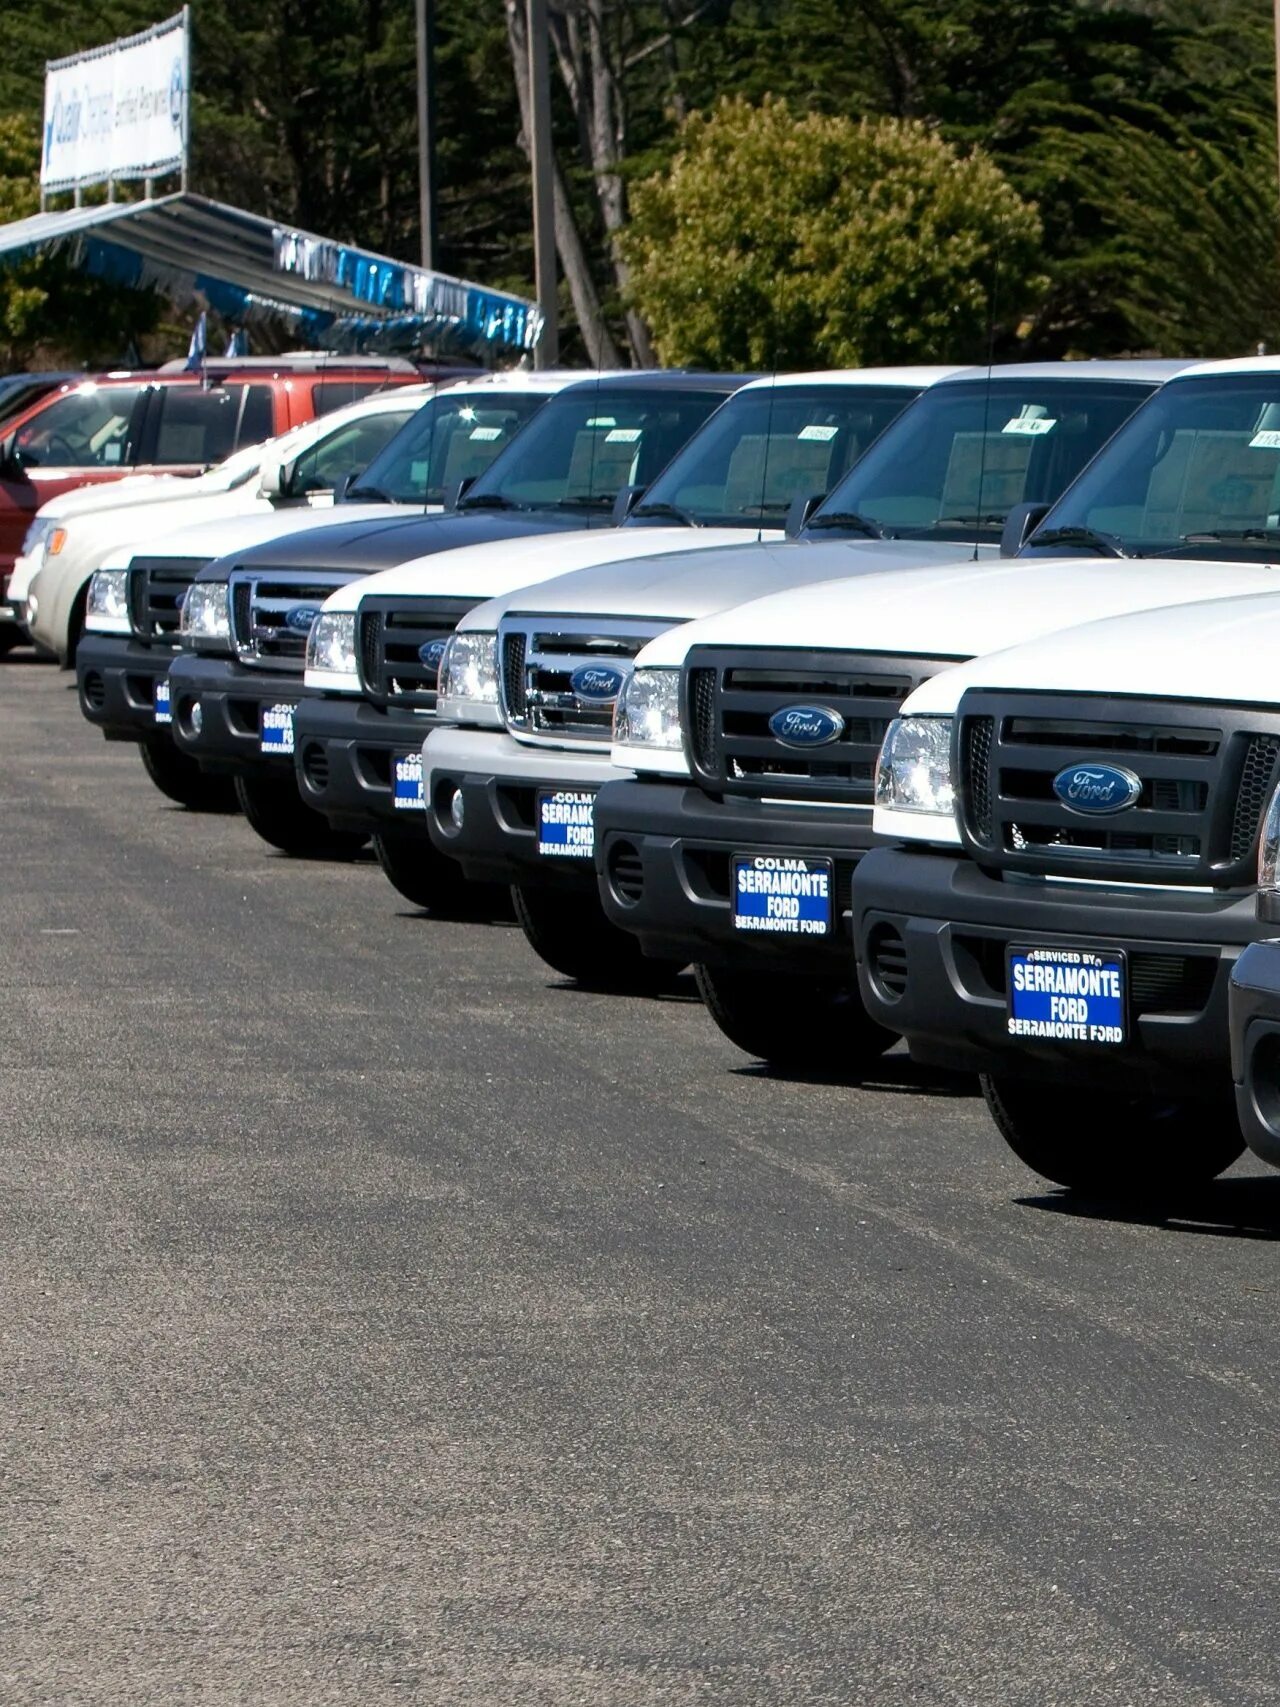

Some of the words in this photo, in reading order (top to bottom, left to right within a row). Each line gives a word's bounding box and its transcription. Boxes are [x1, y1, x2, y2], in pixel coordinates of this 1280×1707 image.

[581, 670, 615, 692] Ford
[782, 712, 822, 736] Ford
[1068, 771, 1115, 800] Ford
[556, 792, 596, 804] COLM
[566, 825, 594, 845] FORD
[754, 858, 808, 872] COLMA
[738, 869, 828, 897] SERRAMONTE
[767, 896, 800, 918] FORD
[735, 915, 798, 932] SERRAMONTE
[801, 920, 826, 934] FORD
[1034, 950, 1080, 964] SERVICED
[1082, 954, 1095, 965] BY
[1014, 964, 1120, 998] SERRAMONTE
[1050, 996, 1088, 1022] FORD
[1008, 1018, 1087, 1040] SERRAMONTE
[1090, 1025, 1122, 1042] FORD
